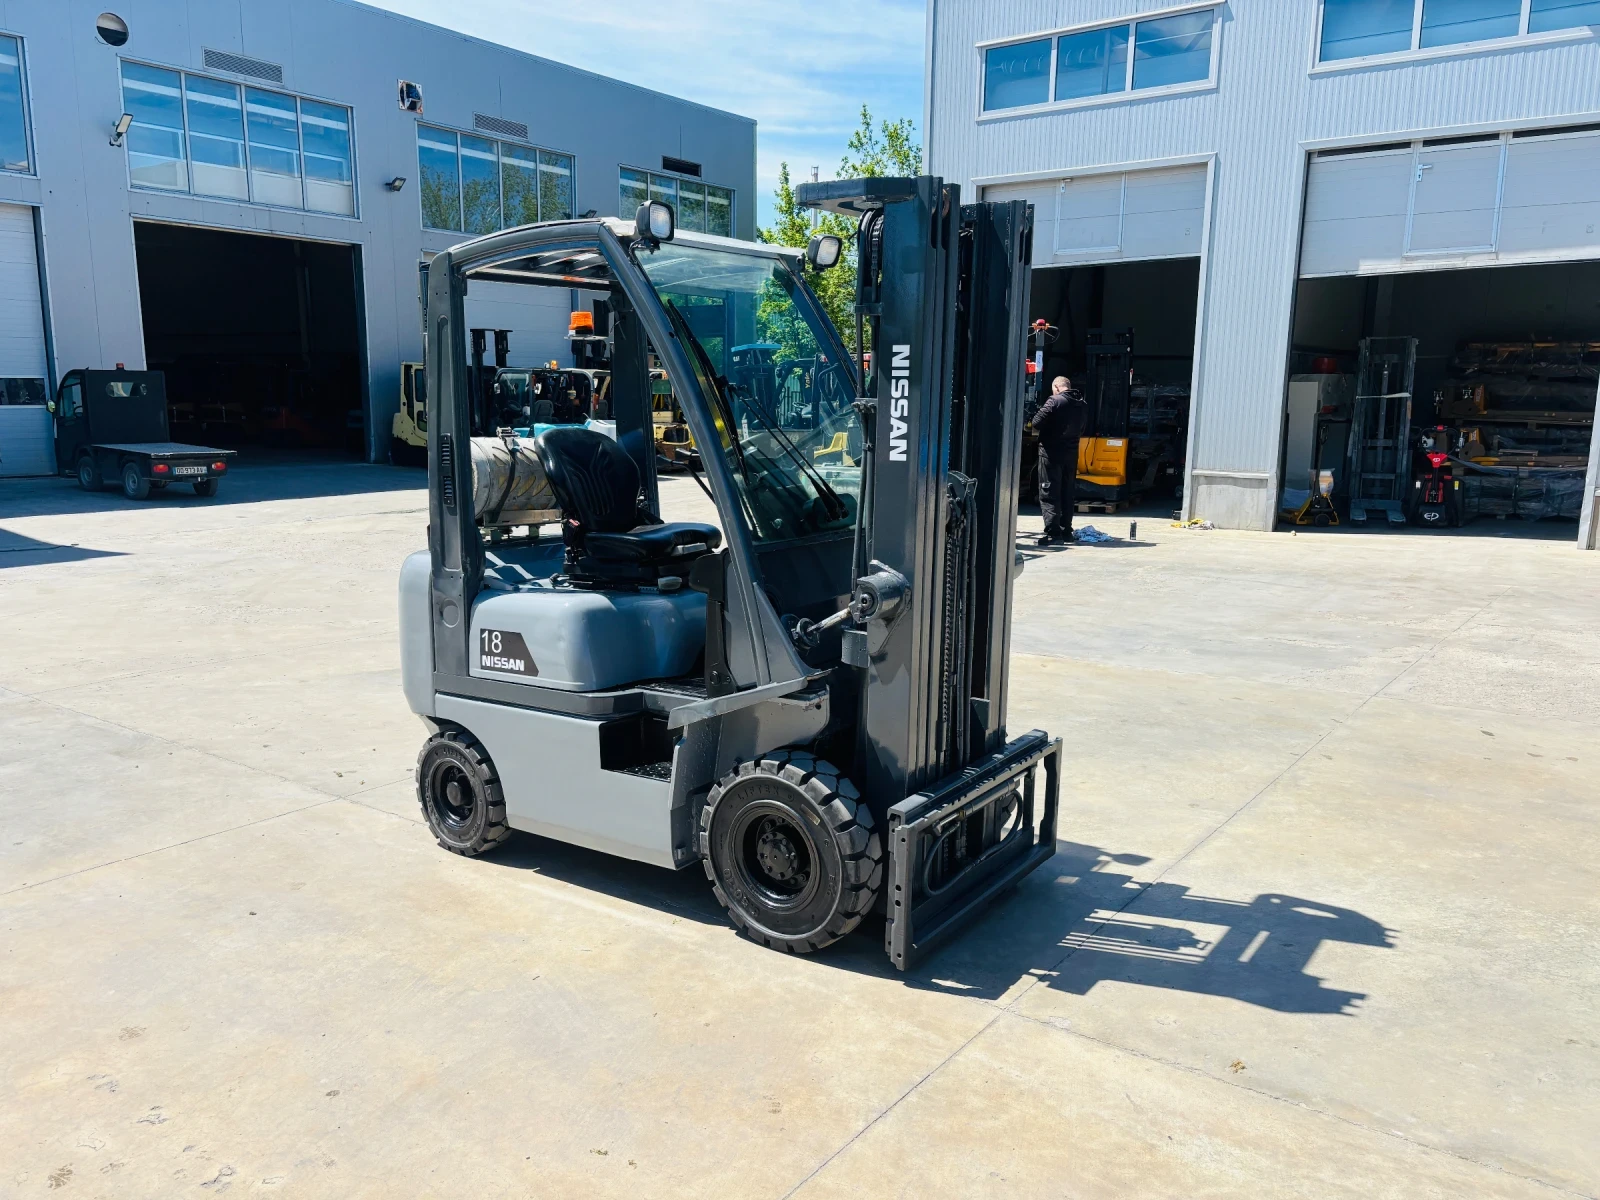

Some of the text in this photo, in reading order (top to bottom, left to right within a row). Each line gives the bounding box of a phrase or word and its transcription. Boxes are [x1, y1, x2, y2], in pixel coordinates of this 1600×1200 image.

[889, 344, 910, 461] NISSAN
[481, 630, 502, 653] 18
[481, 654, 525, 671] NISSAN
